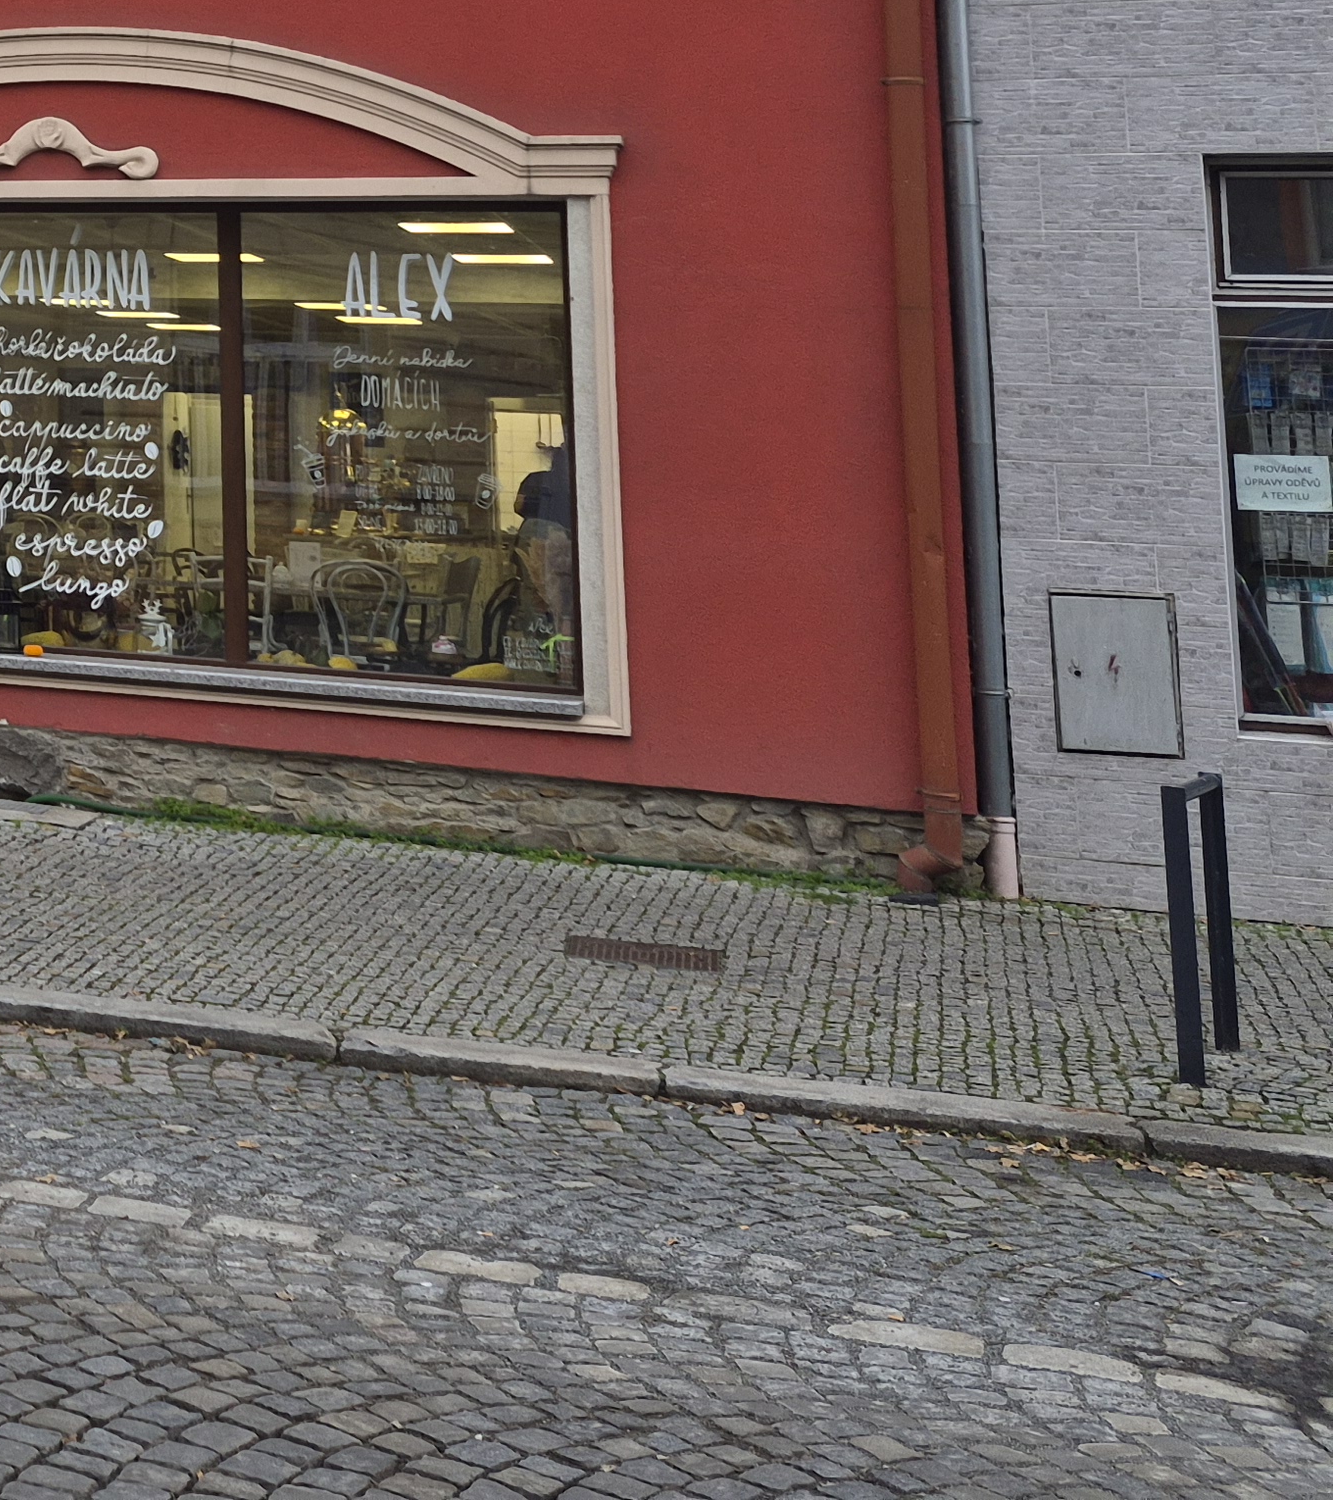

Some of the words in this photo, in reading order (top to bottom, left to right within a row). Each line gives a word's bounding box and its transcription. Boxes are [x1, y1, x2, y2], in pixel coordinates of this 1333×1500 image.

[341, 251, 453, 321] ALEX
[53, 333, 176, 365] čokoláda
[333, 345, 393, 369] Denní
[360, 371, 441, 412] DOMÁCÍCH
[405, 429, 422, 439] a
[72, 447, 156, 479] latte
[1253, 464, 1313, 475] PROVÁDÍME
[1244, 476, 1283, 487] ÚPRAVY
[1285, 477, 1321, 488] ODĚVŮ
[1261, 491, 1268, 499] A
[1271, 492, 1310, 501] TEXTILU
[61, 485, 153, 519] white
[15, 532, 147, 567] espresso
[19, 560, 129, 609] lungo
